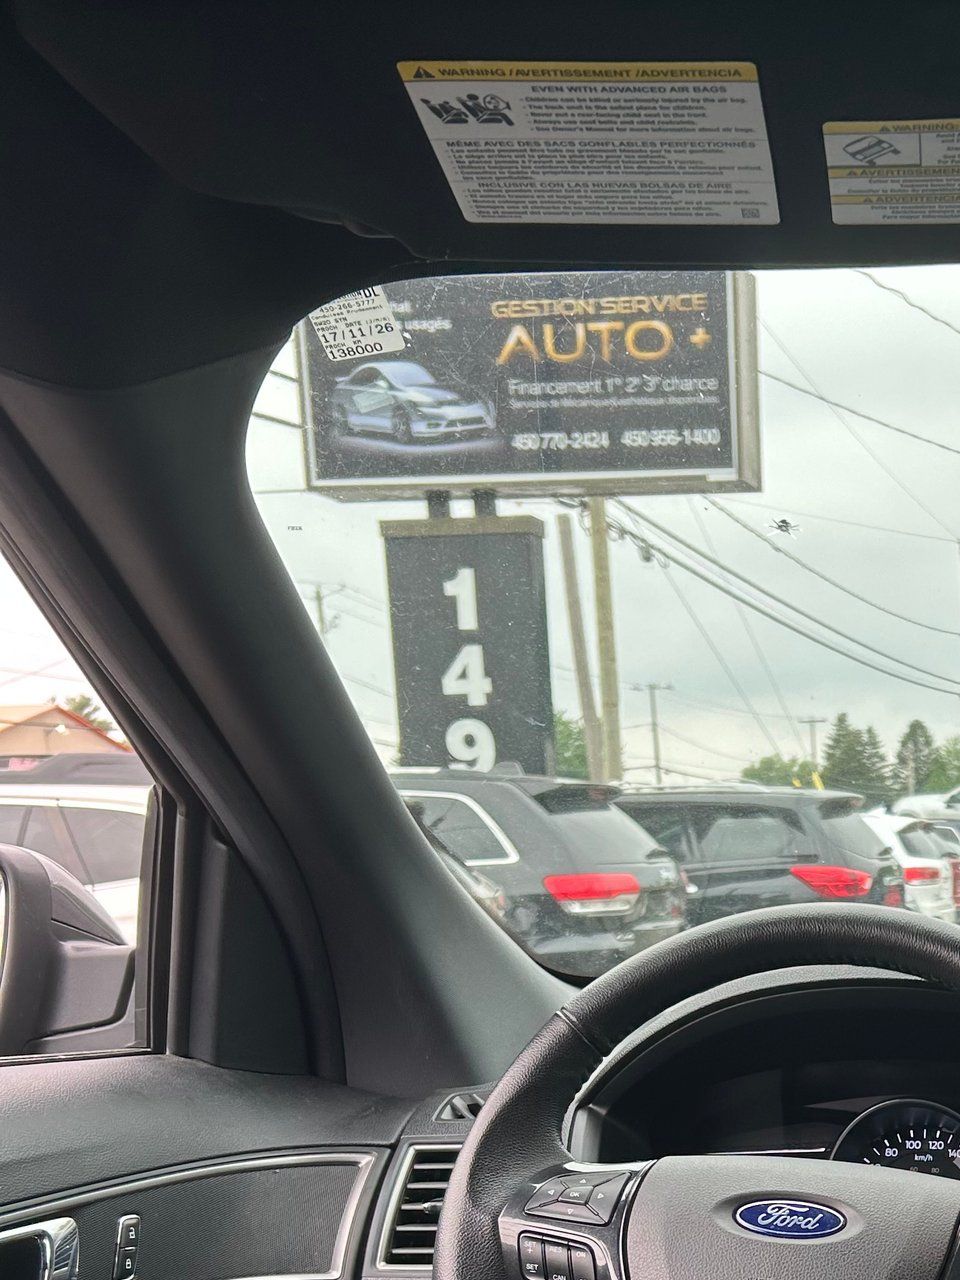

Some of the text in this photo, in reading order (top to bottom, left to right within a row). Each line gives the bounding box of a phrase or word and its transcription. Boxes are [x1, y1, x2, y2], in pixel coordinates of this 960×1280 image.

[438, 68, 505, 77] WARNING
[515, 68, 631, 78] AVERTISSEMENT
[531, 85, 564, 93] EVEN
[567, 85, 598, 93] WITH
[692, 86, 727, 94] BAGS
[446, 140, 481, 148] MÊME
[484, 140, 514, 148] AVEC
[517, 140, 541, 148] DES
[544, 140, 576, 148] SACS
[578, 140, 657, 148] GONFLABLES
[490, 293, 709, 318] GESTION SERVICE
[316, 325, 338, 333] PROCH
[345, 320, 362, 328] DATE
[325, 342, 347, 350] PROCH
[496, 319, 674, 366] AUTO
[328, 342, 383, 360] 138000
[905, 1140, 944, 1150] 100 120
[884, 1147, 899, 1157] 80
[914, 1153, 933, 1162] km/h
[570, 1190, 580, 1198] OK
[757, 1203, 821, 1231] Ford
[523, 1240, 537, 1248] SET
